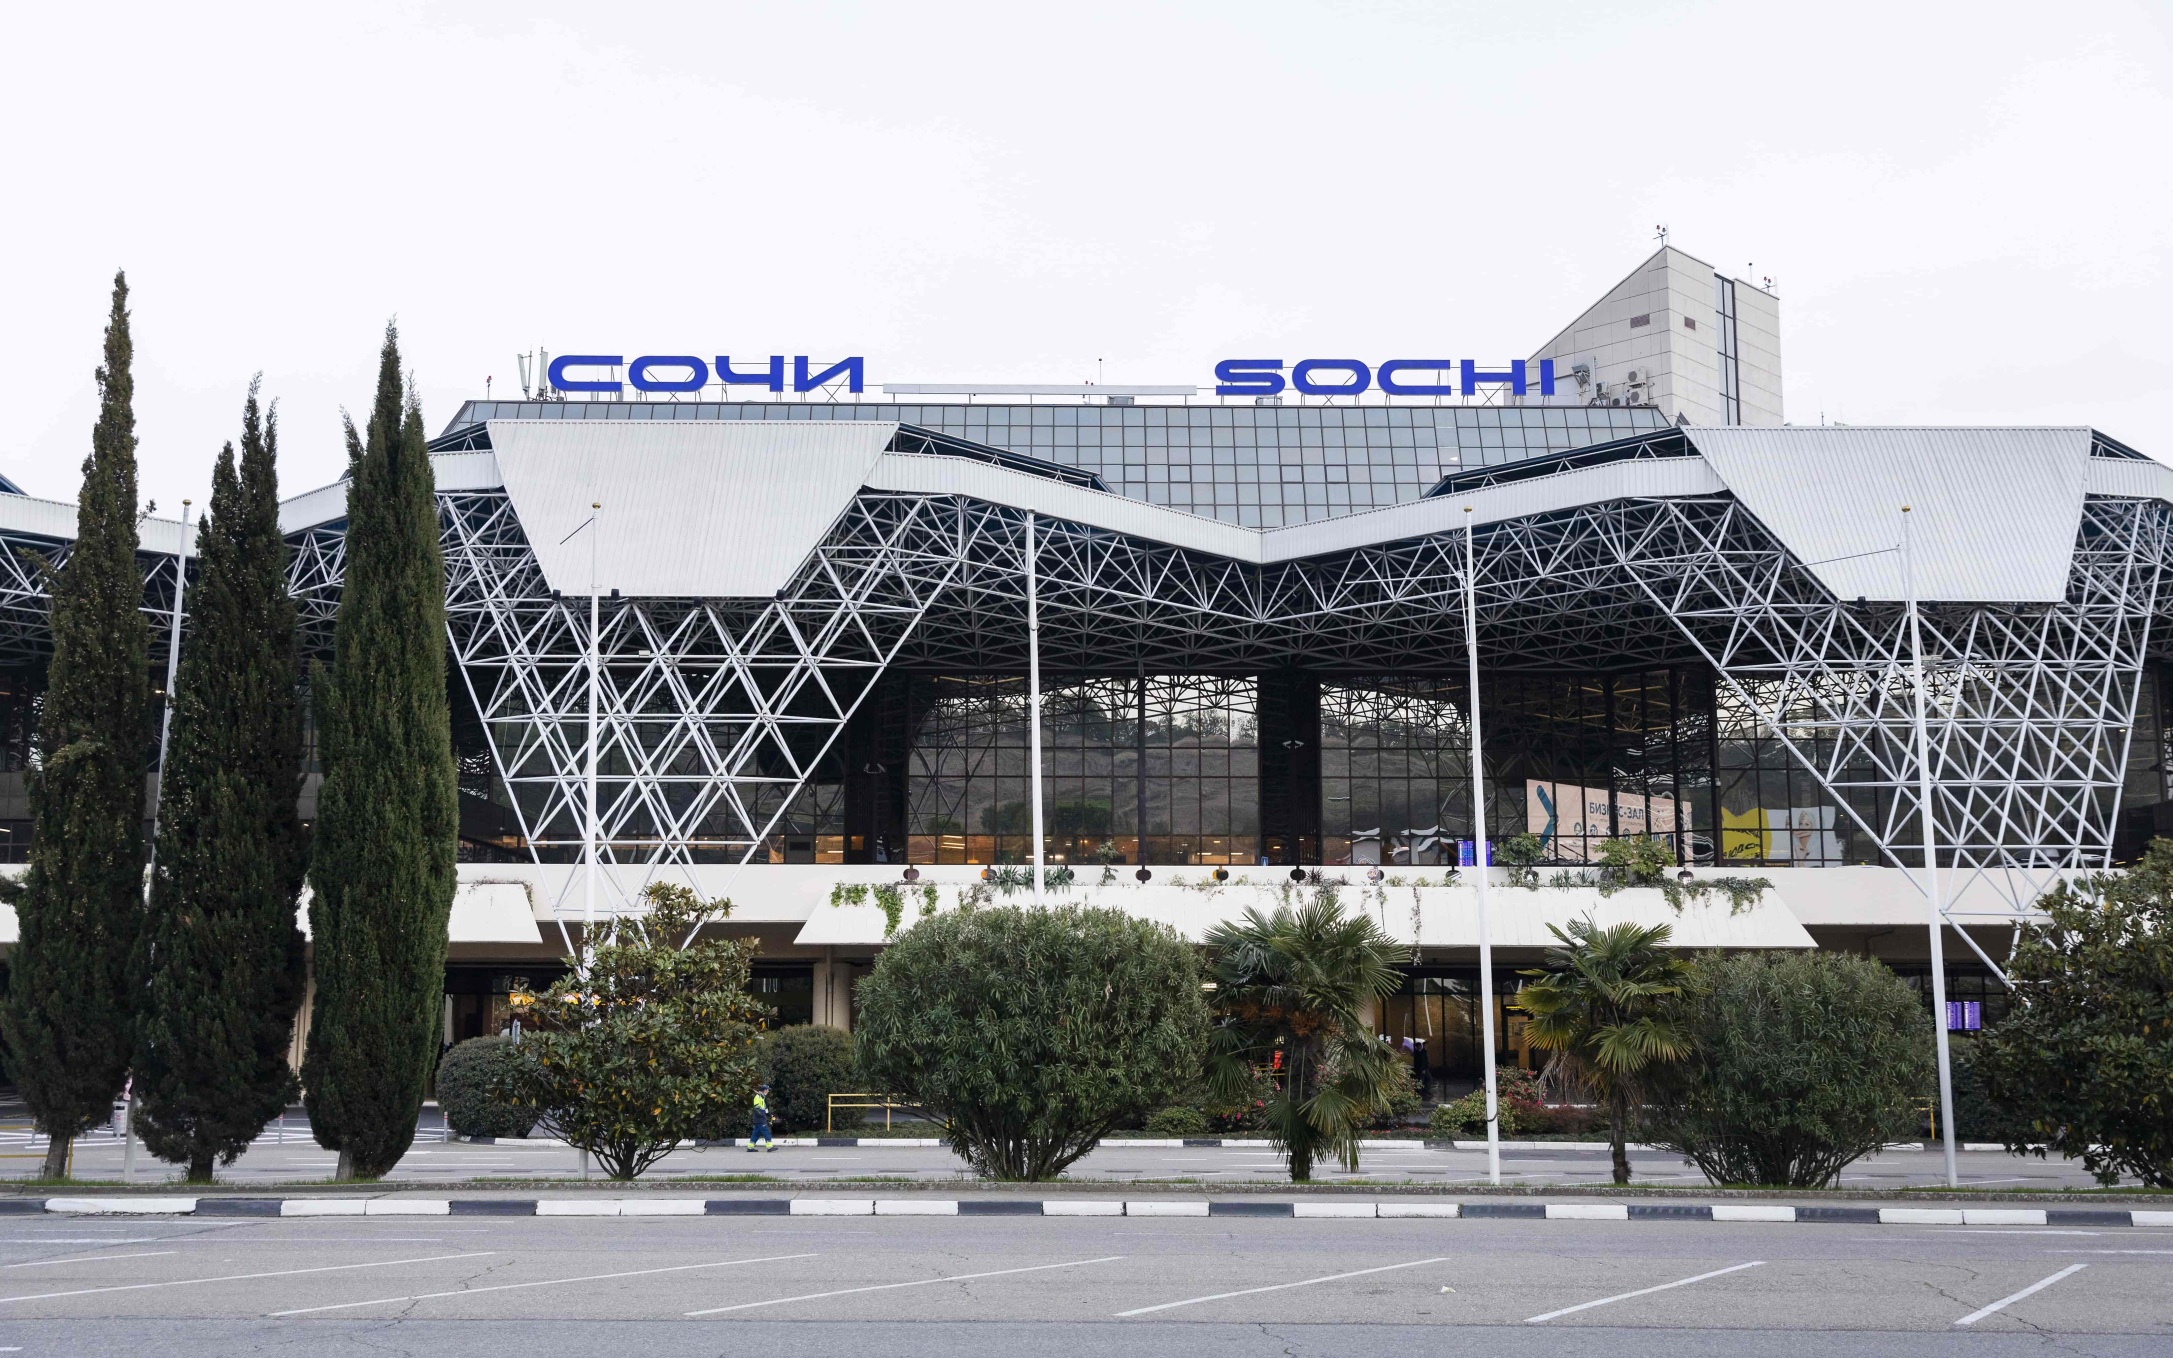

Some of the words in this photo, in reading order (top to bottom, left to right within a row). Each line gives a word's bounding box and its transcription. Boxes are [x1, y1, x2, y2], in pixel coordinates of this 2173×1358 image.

[547, 355, 864, 394] СОЧИ
[1214, 358, 1555, 397] SOCHI
[1589, 802, 1645, 821] БИЗС-ЗАЛ
